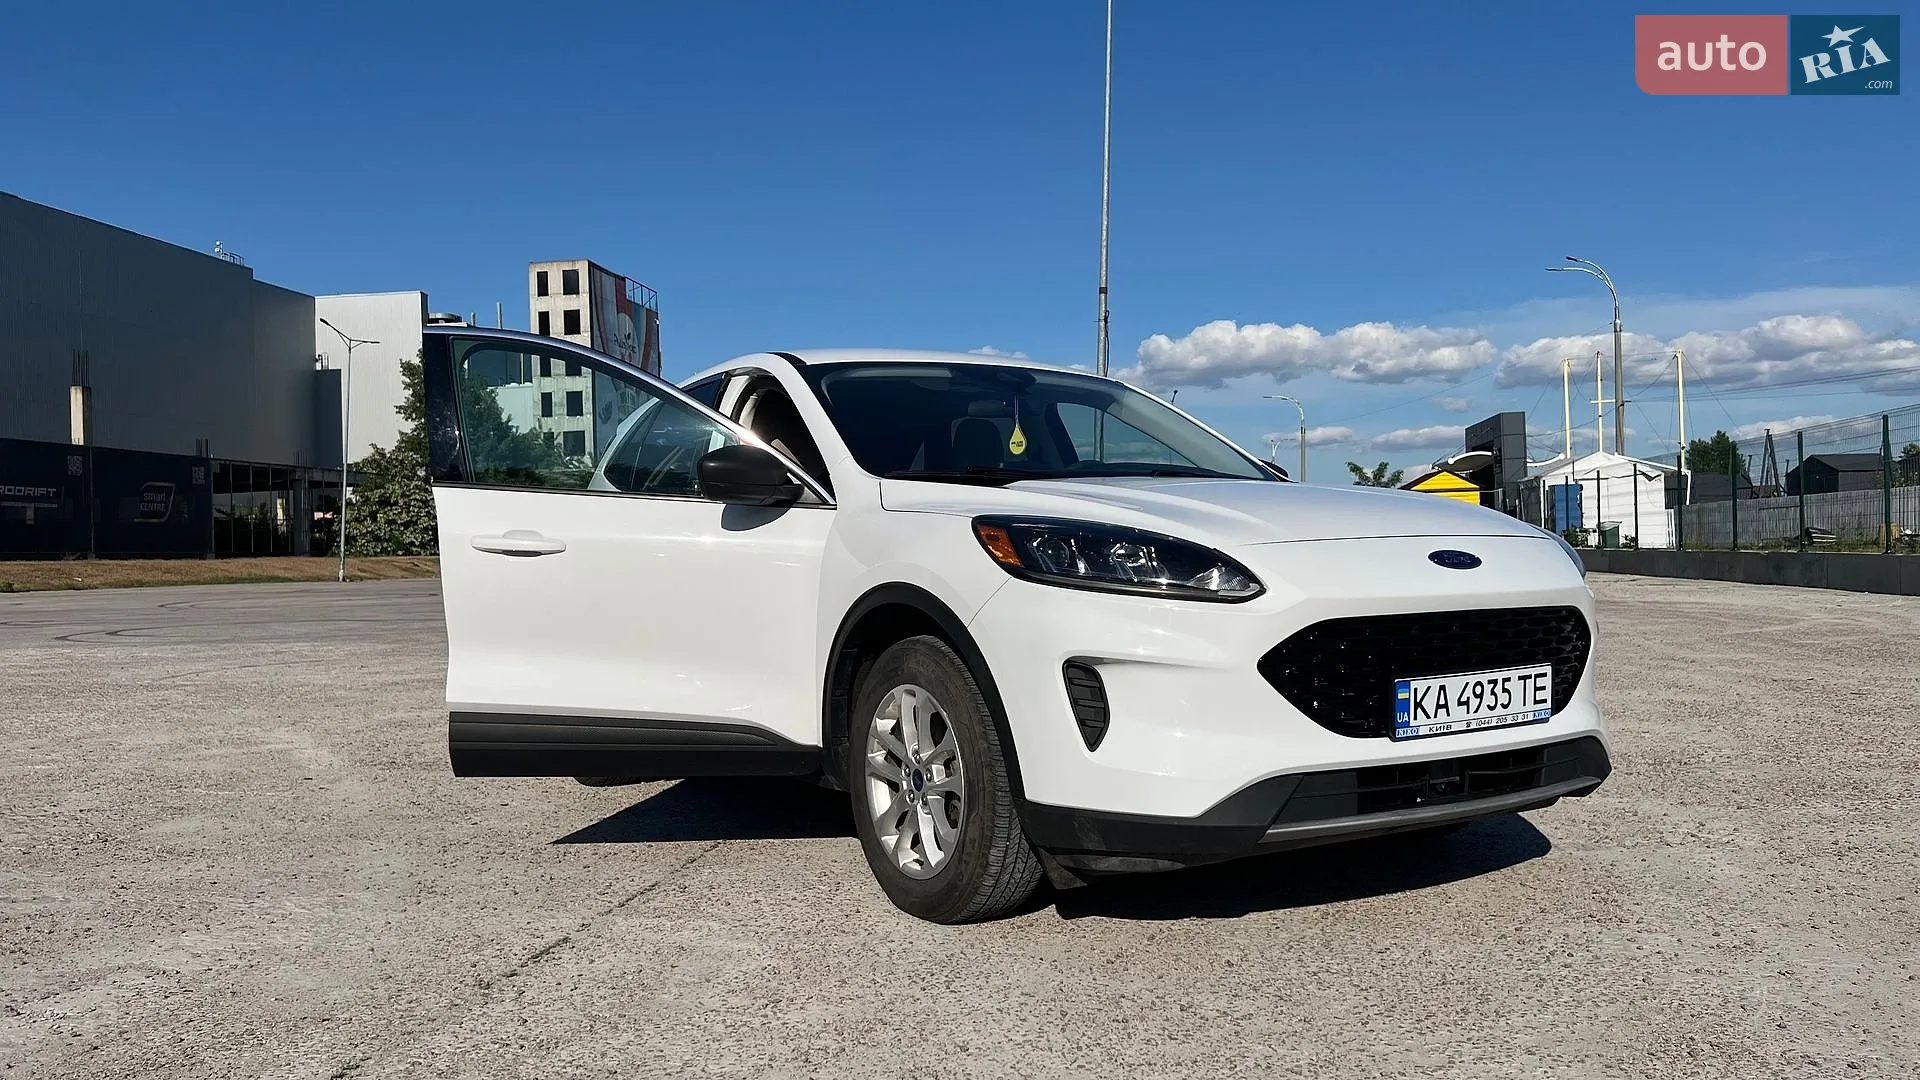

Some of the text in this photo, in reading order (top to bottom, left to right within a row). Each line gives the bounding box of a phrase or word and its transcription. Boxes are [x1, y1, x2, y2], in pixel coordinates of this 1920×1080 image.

[140, 503, 167, 512] CENTRE
[1457, 676, 1512, 715] 4935
[1517, 672, 1548, 707] TE
[1397, 711, 1409, 723] UA
[1475, 713, 1530, 727] (044) 205 33 31
